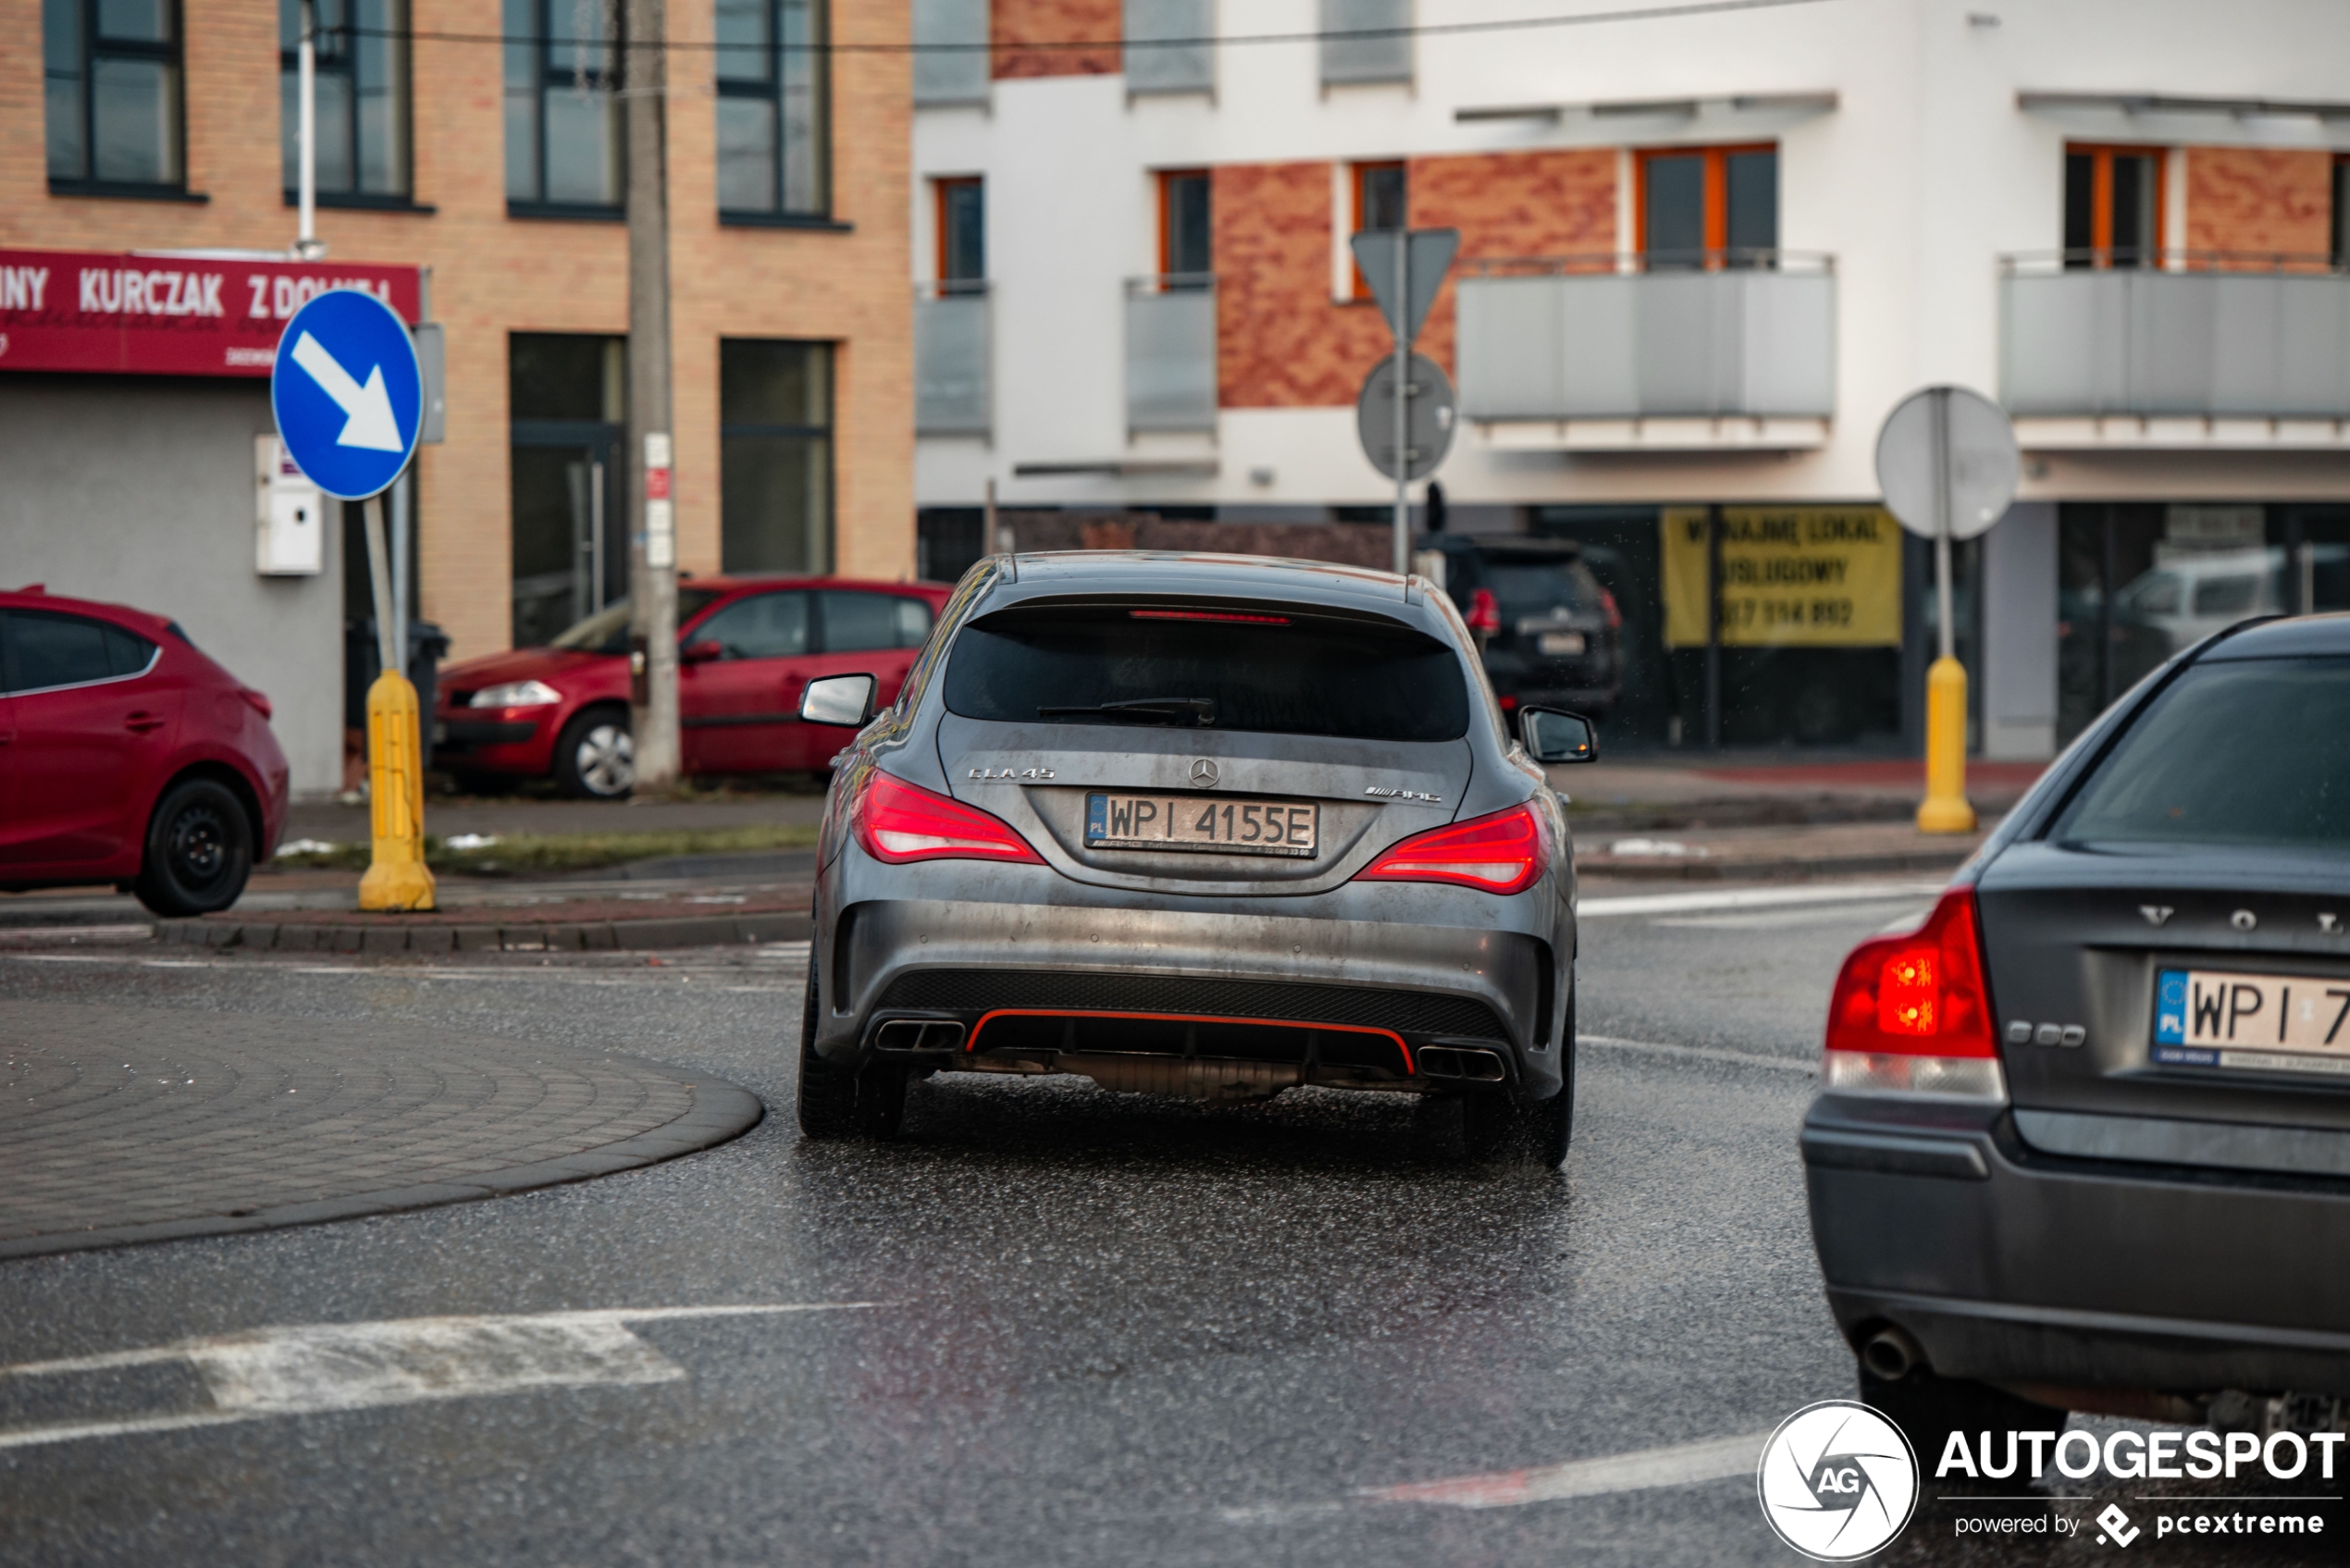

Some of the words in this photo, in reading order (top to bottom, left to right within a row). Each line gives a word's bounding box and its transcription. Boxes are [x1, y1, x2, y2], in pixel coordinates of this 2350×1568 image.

[79, 267, 225, 317] KURCZAK
[968, 768, 1016, 780] CLA
[1021, 768, 1055, 780] 45
[1090, 822, 1105, 833] PL
[1111, 799, 1173, 838] WPI
[1195, 803, 1311, 846] 4155E
[2159, 1012, 2183, 1034] PL
[2195, 981, 2290, 1043] WPI
